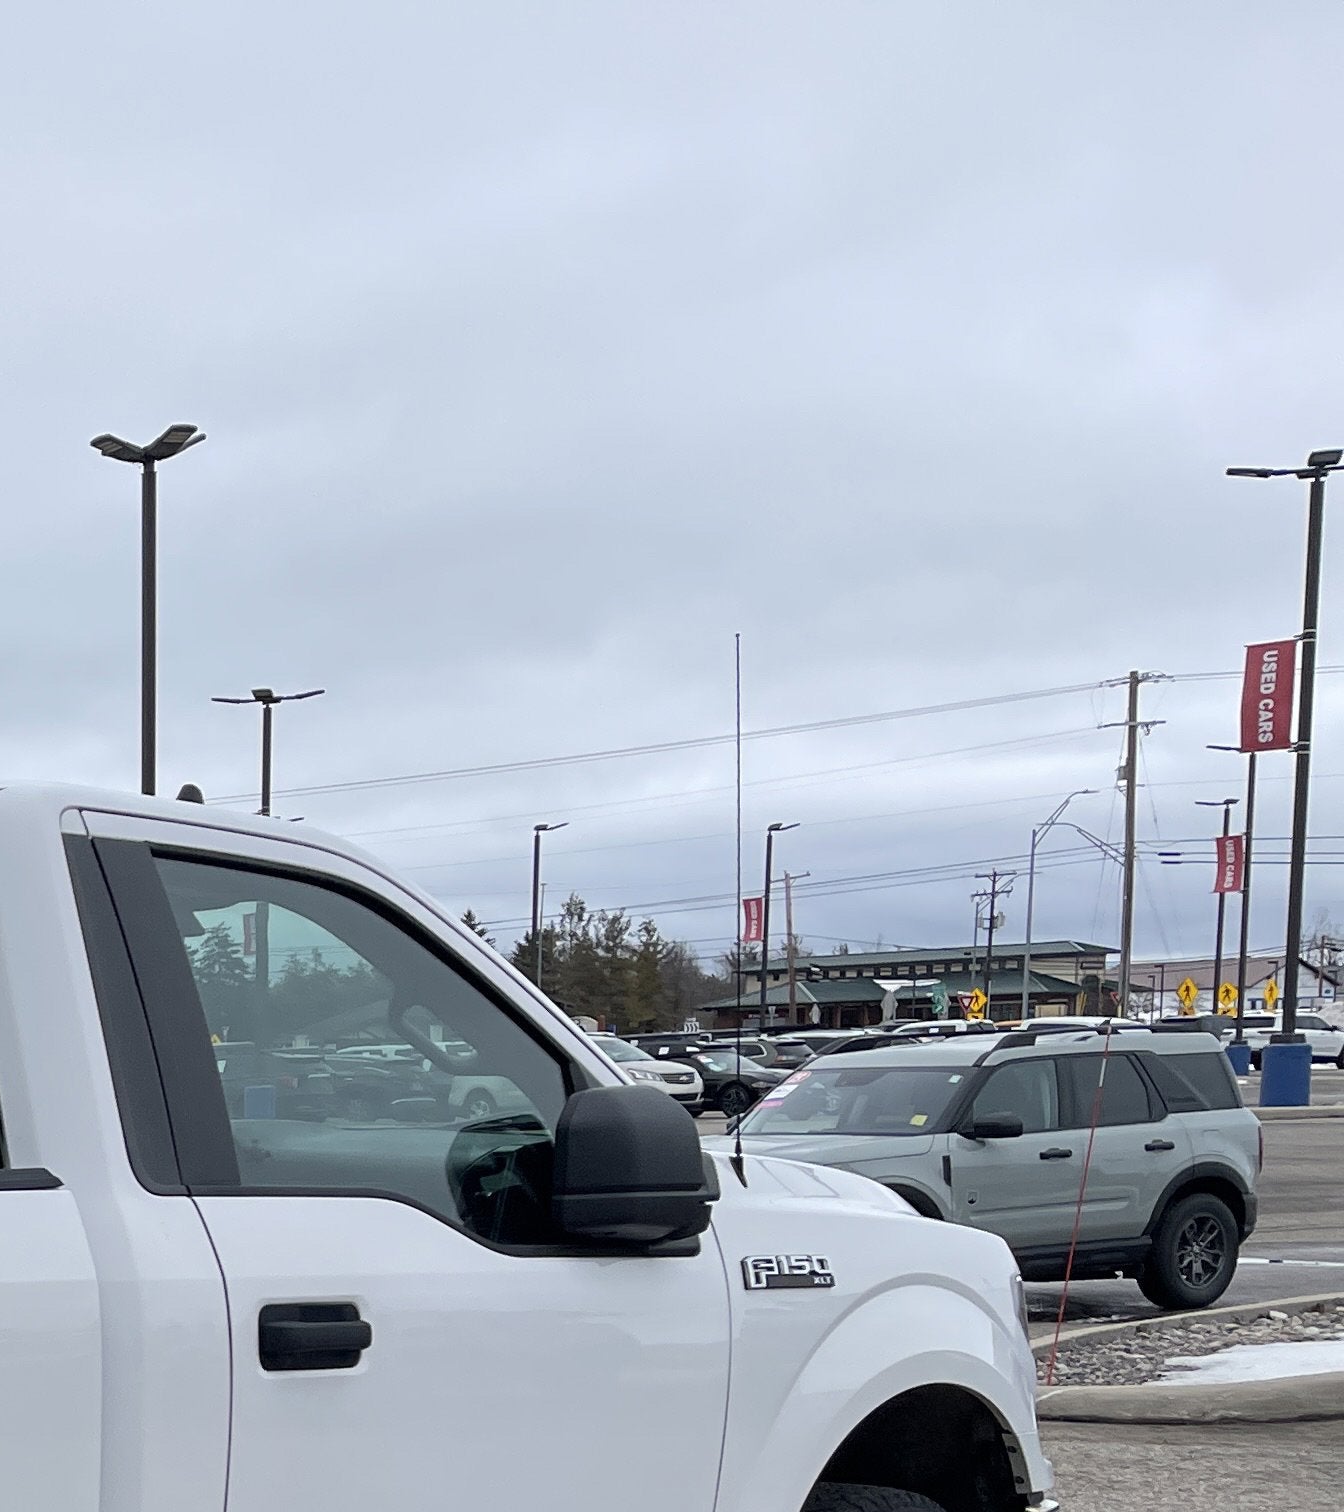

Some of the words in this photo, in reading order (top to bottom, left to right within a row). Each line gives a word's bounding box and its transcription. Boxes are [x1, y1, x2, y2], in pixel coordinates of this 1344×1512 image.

[1259, 650, 1279, 694] USED
[1257, 698, 1275, 744] CARS
[1225, 840, 1235, 863] USED
[1224, 865, 1234, 888] CARS
[813, 1276, 832, 1284] XLT
